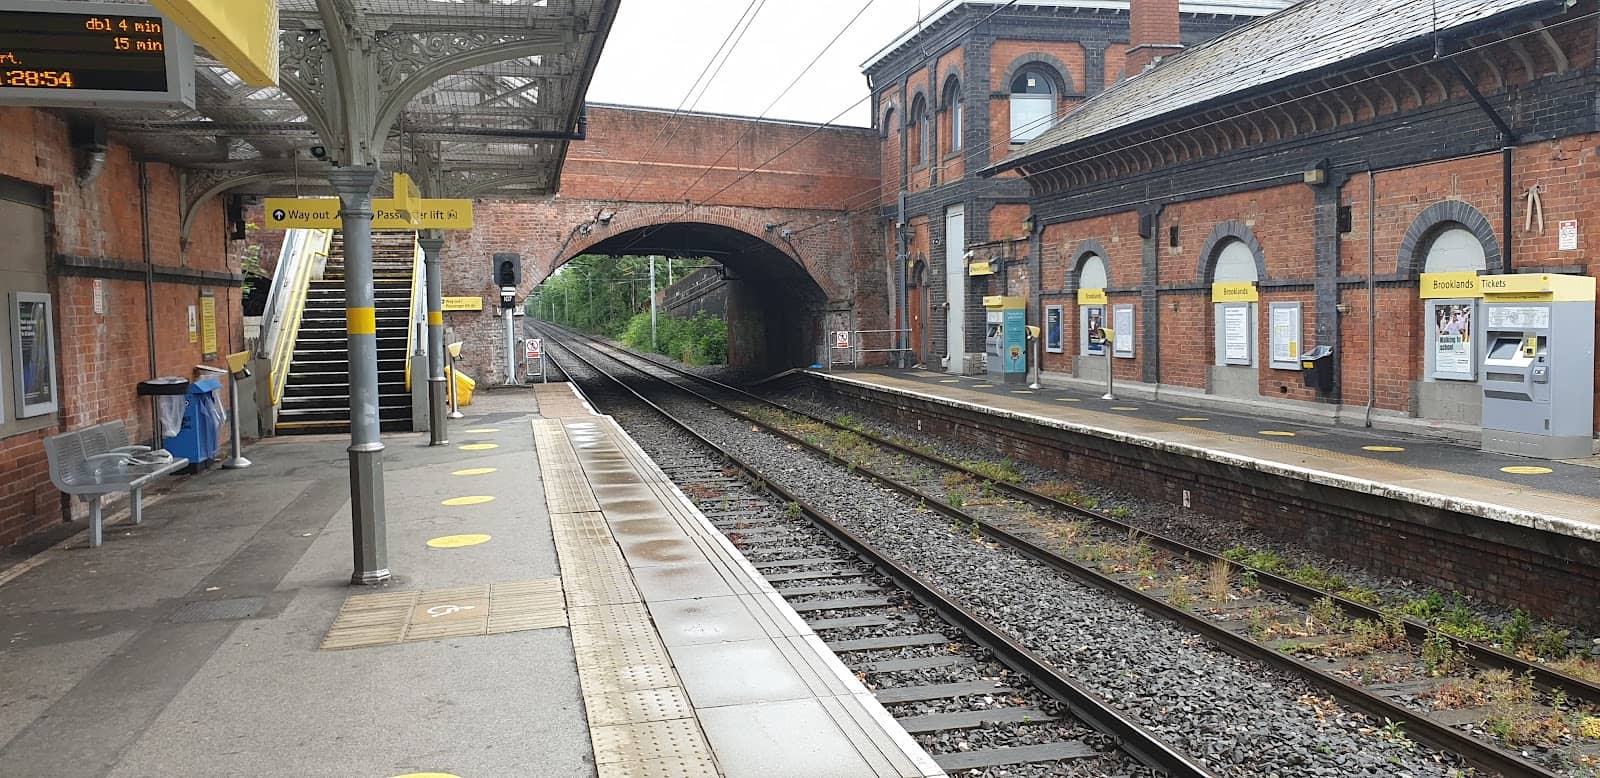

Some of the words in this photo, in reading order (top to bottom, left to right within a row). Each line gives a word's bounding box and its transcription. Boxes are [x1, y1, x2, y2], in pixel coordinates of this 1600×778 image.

[86, 18, 112, 31] dbl
[118, 19, 128, 31] 4
[134, 20, 161, 33] min
[113, 37, 129, 50] 15
[136, 38, 162, 51] min
[288, 209, 310, 222] Way
[312, 211, 330, 219] out
[377, 210, 427, 220] Passer
[430, 209, 444, 220] lift
[1433, 280, 1474, 289] Brooklands
[1482, 280, 1506, 288] Tickets
[1223, 287, 1249, 296] Brooklands
[1440, 336, 1455, 344] Walking
